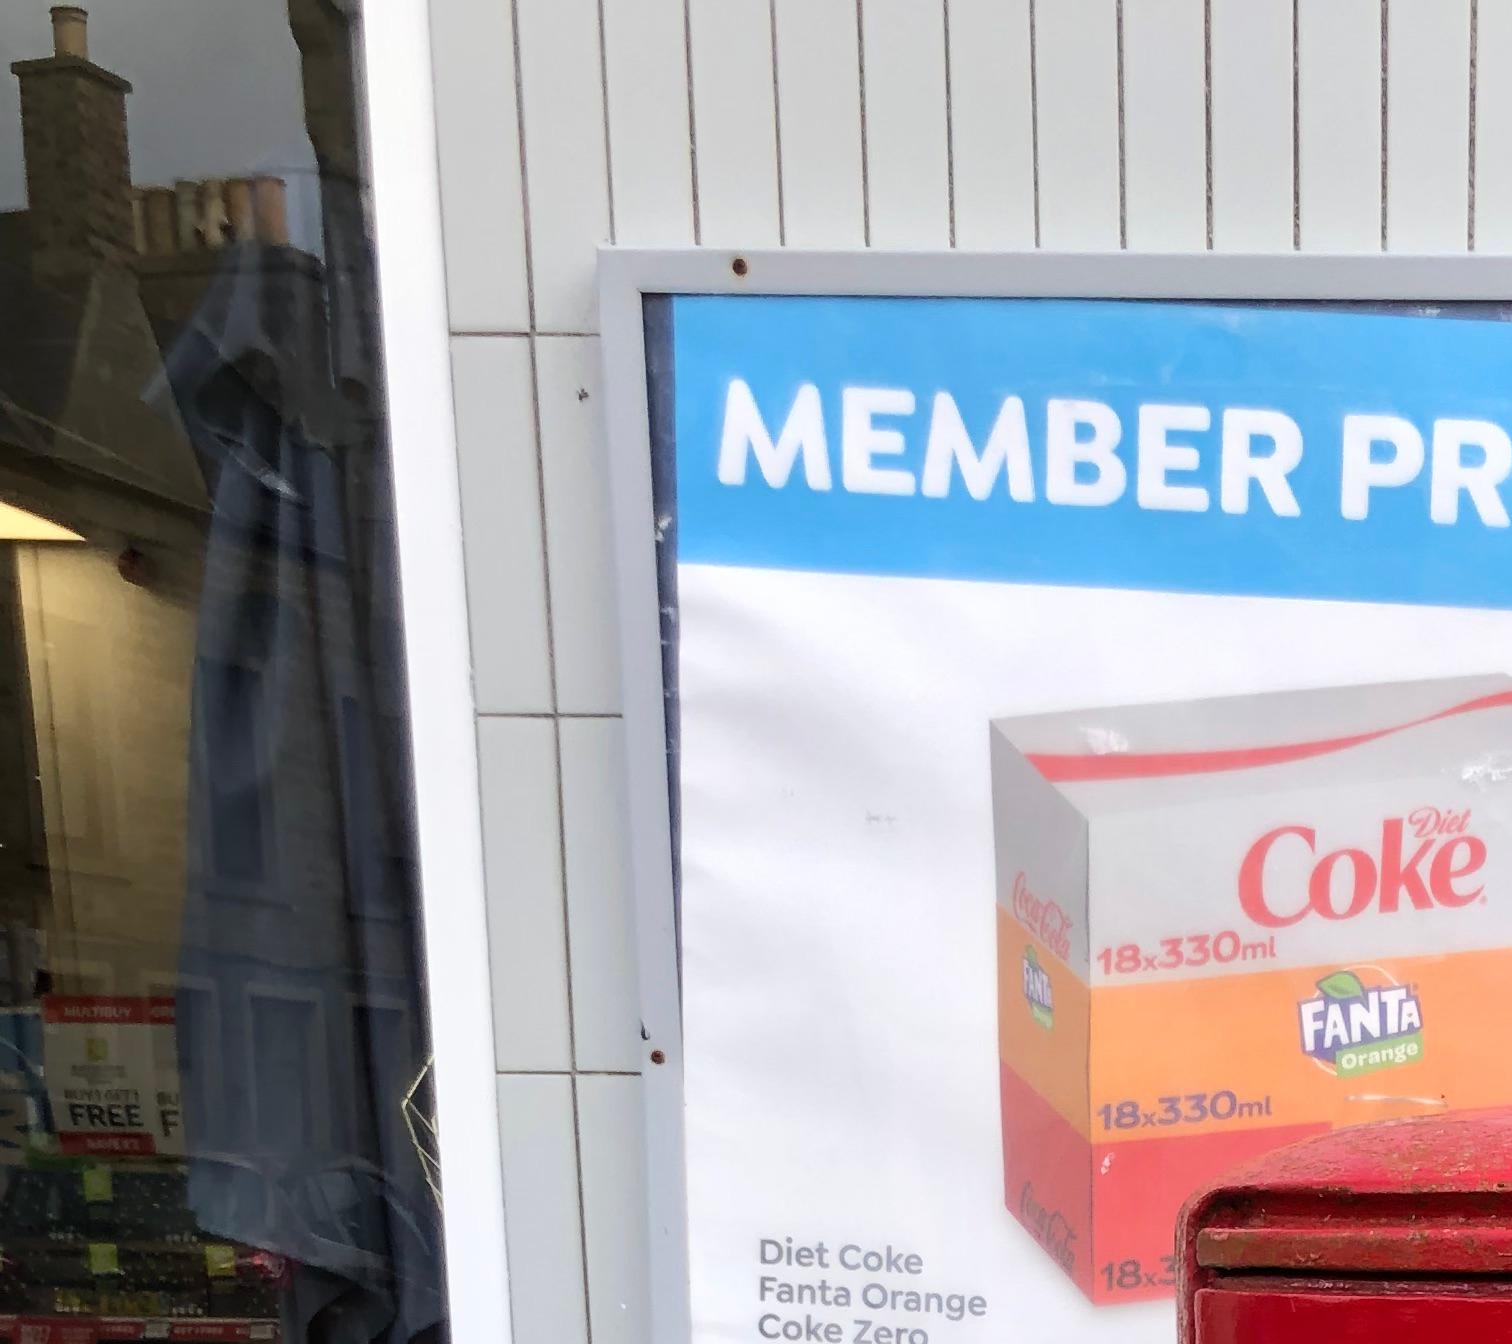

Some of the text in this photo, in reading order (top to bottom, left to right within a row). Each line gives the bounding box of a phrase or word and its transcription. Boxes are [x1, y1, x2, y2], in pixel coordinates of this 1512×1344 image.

[718, 378, 1304, 520] MEMBER
[1408, 806, 1471, 840] Diet
[1237, 818, 1488, 929] Coke
[1096, 929, 1277, 976] 18x330ml
[1300, 987, 1422, 1053] FANTA
[1341, 1041, 1418, 1070] Orange
[69, 1103, 144, 1127] FREE
[1096, 1090, 1273, 1131] 18x330ml
[758, 1238, 924, 1275] Diet Coke
[1101, 1255, 1178, 1292] 18x3
[758, 1275, 987, 1321] Fanta Orange
[758, 1313, 843, 1344] Coke
